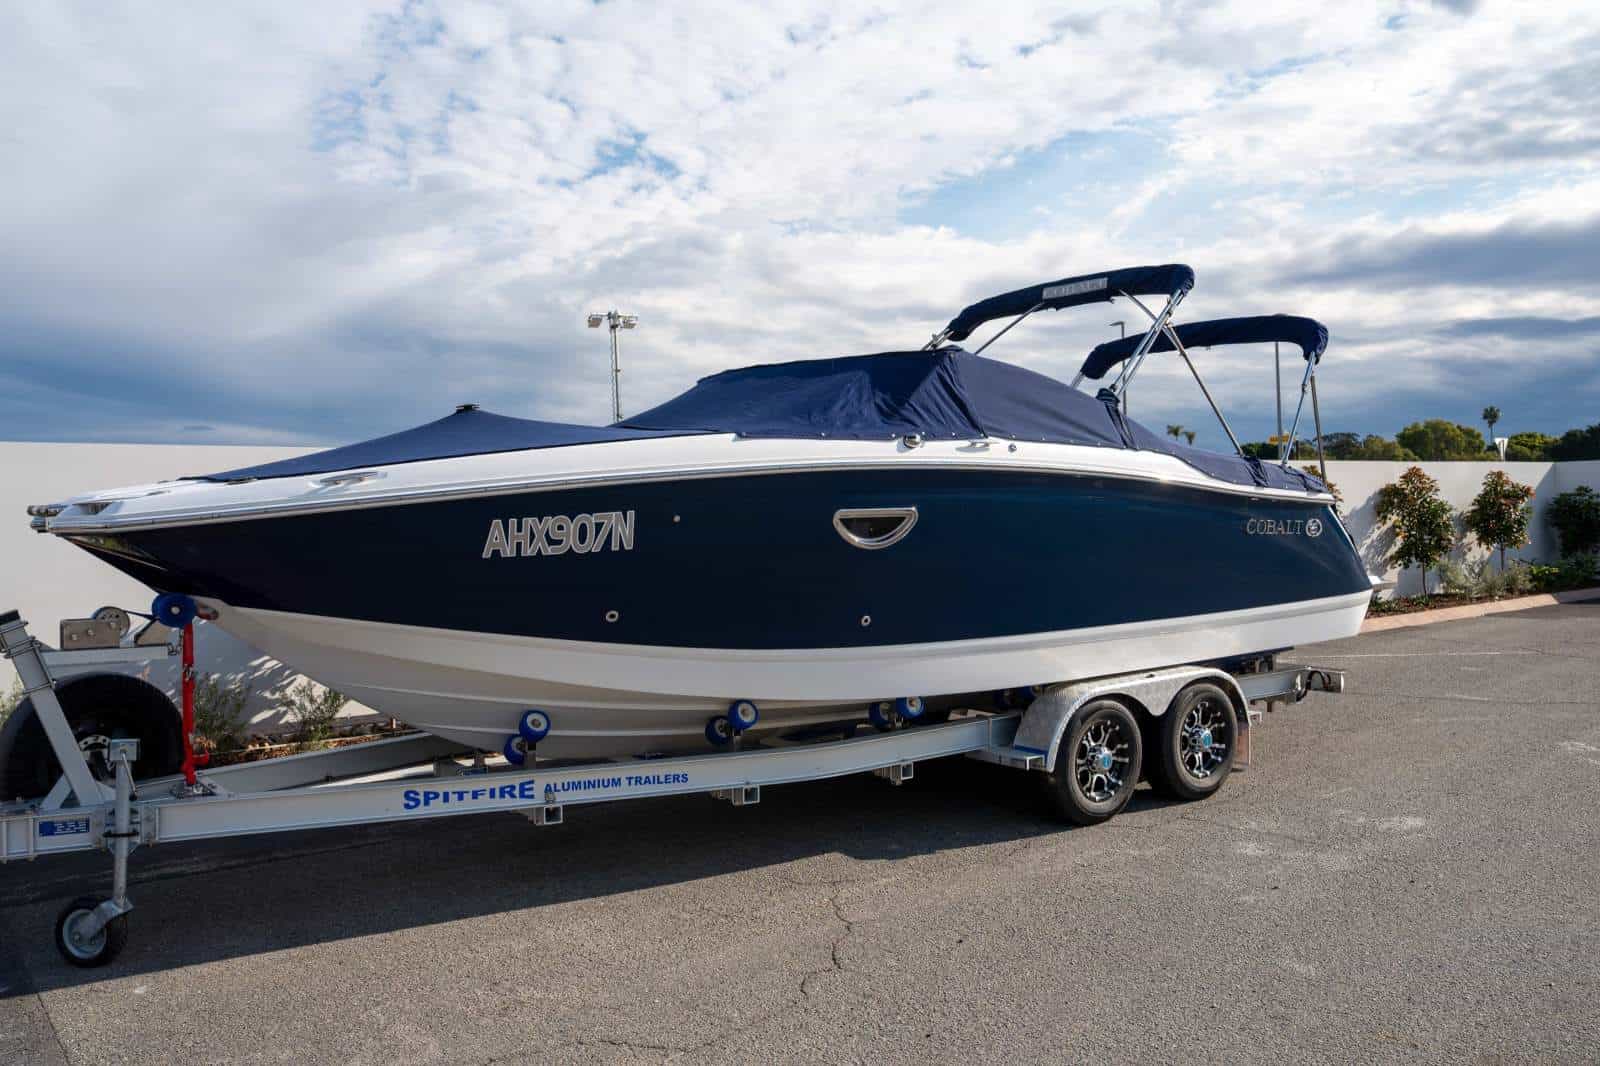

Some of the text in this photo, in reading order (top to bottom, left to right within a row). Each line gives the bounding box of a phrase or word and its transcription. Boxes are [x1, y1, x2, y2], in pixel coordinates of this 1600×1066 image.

[482, 510, 635, 558] AHX907N
[1246, 518, 1304, 535] COBALT
[403, 773, 689, 810] SPITFIRE ALUMINIUM TRAILERS
